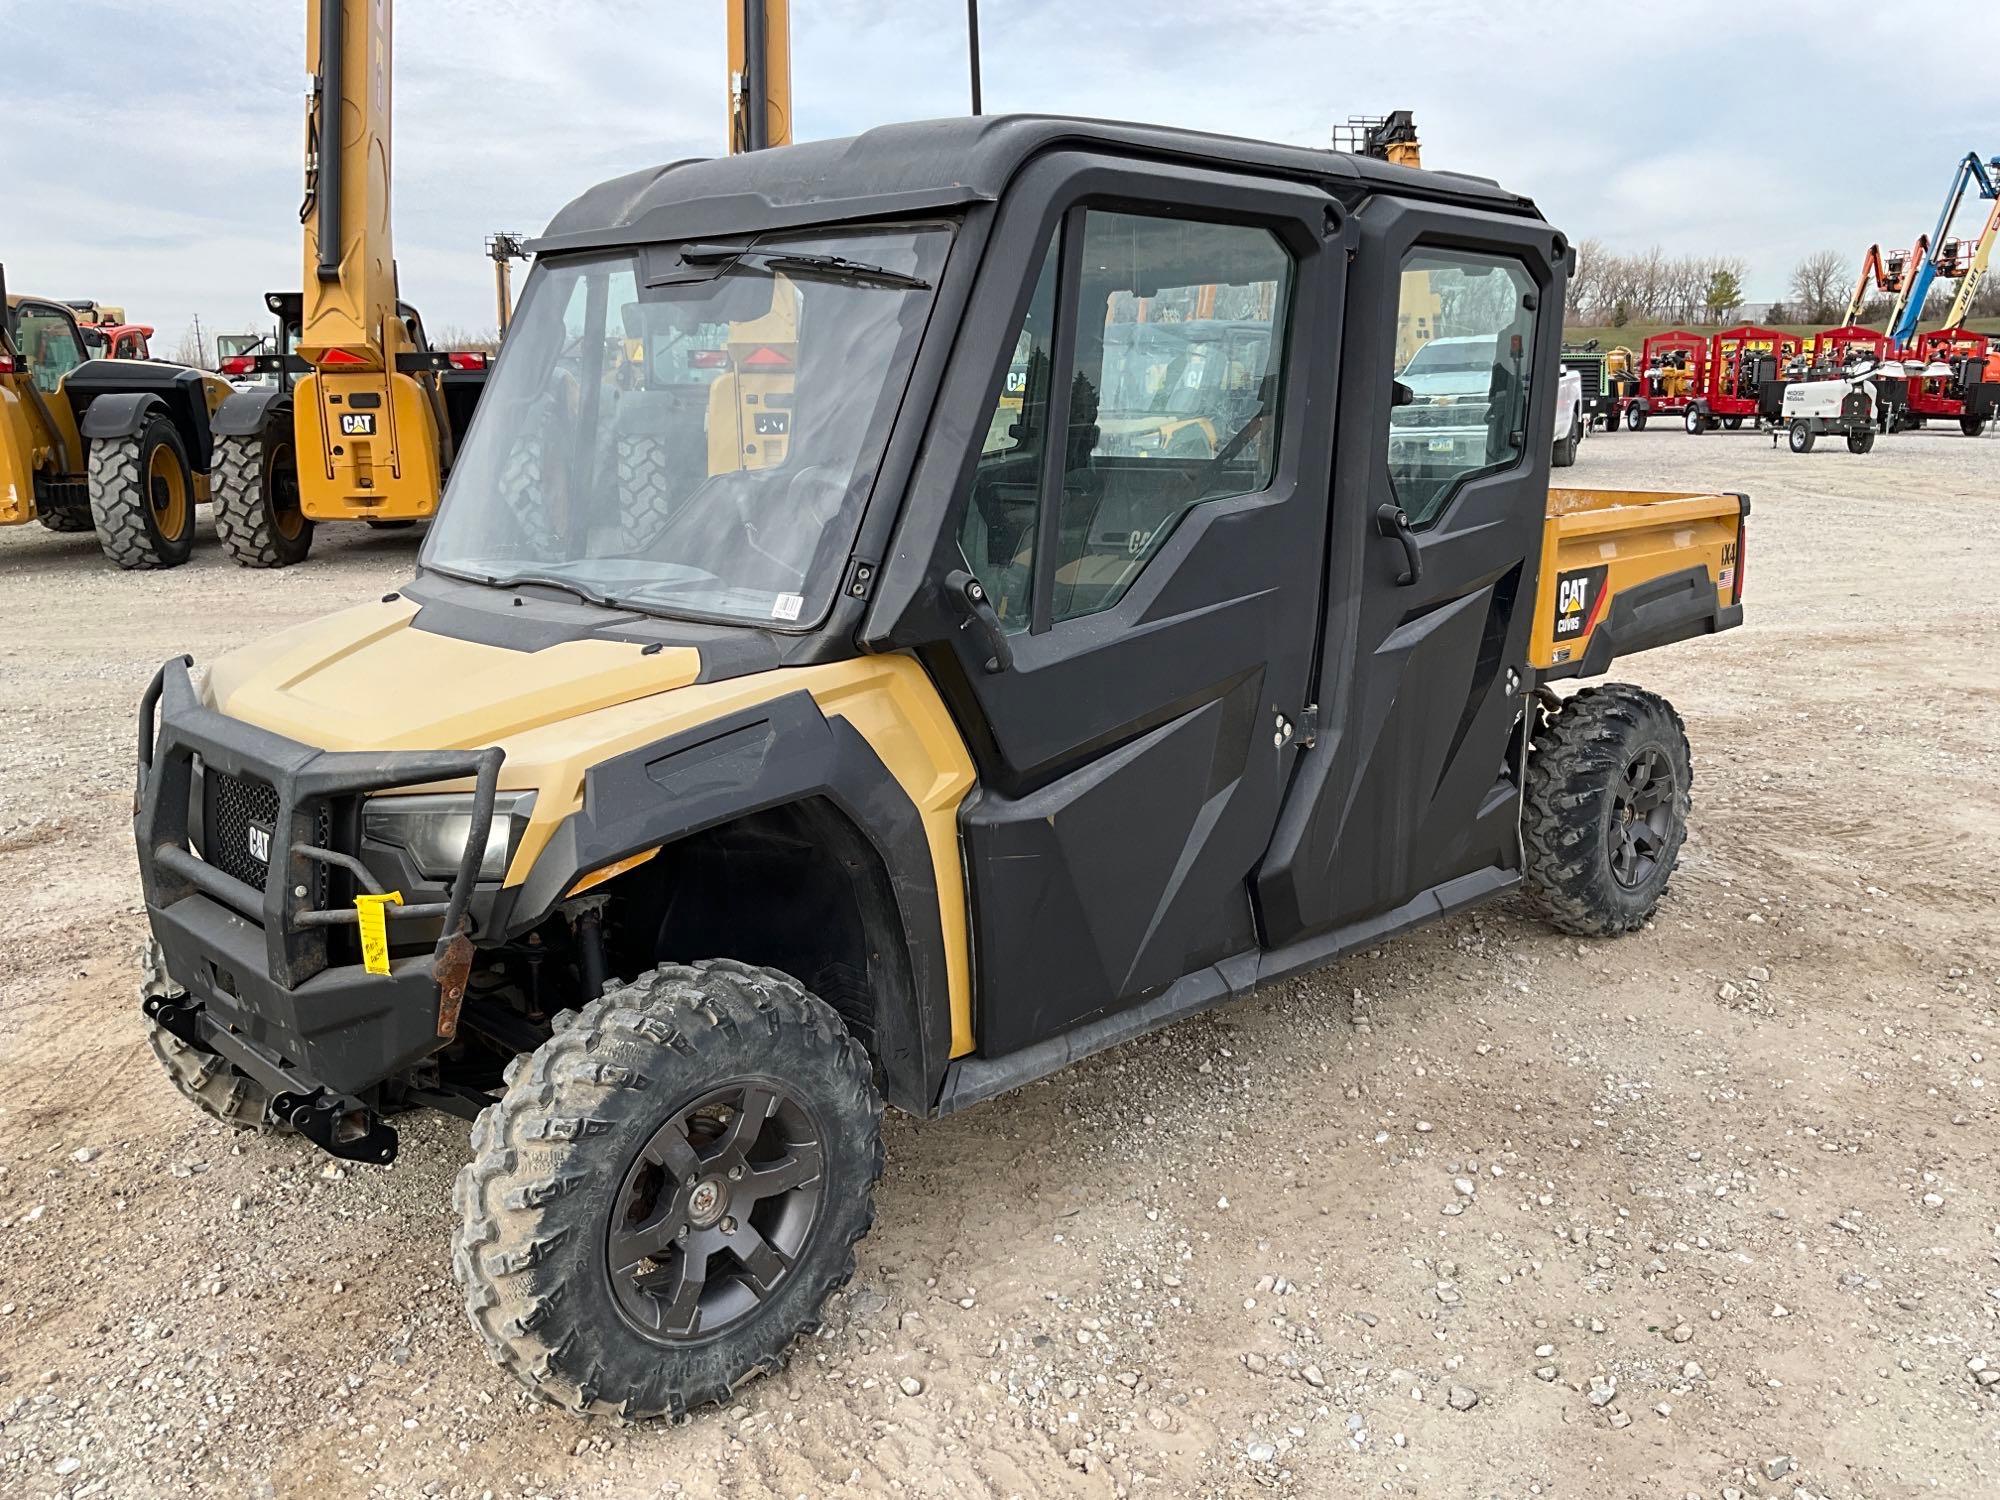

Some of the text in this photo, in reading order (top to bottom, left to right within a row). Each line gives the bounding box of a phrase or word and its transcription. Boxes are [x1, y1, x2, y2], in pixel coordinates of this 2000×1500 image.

[1968, 267, 1979, 288] LIFT
[1007, 372, 1026, 391] CA
[343, 415, 371, 433] CAT
[1129, 530, 1151, 553] CA
[1559, 578, 1588, 613] CAT
[249, 826, 269, 862] CAT
